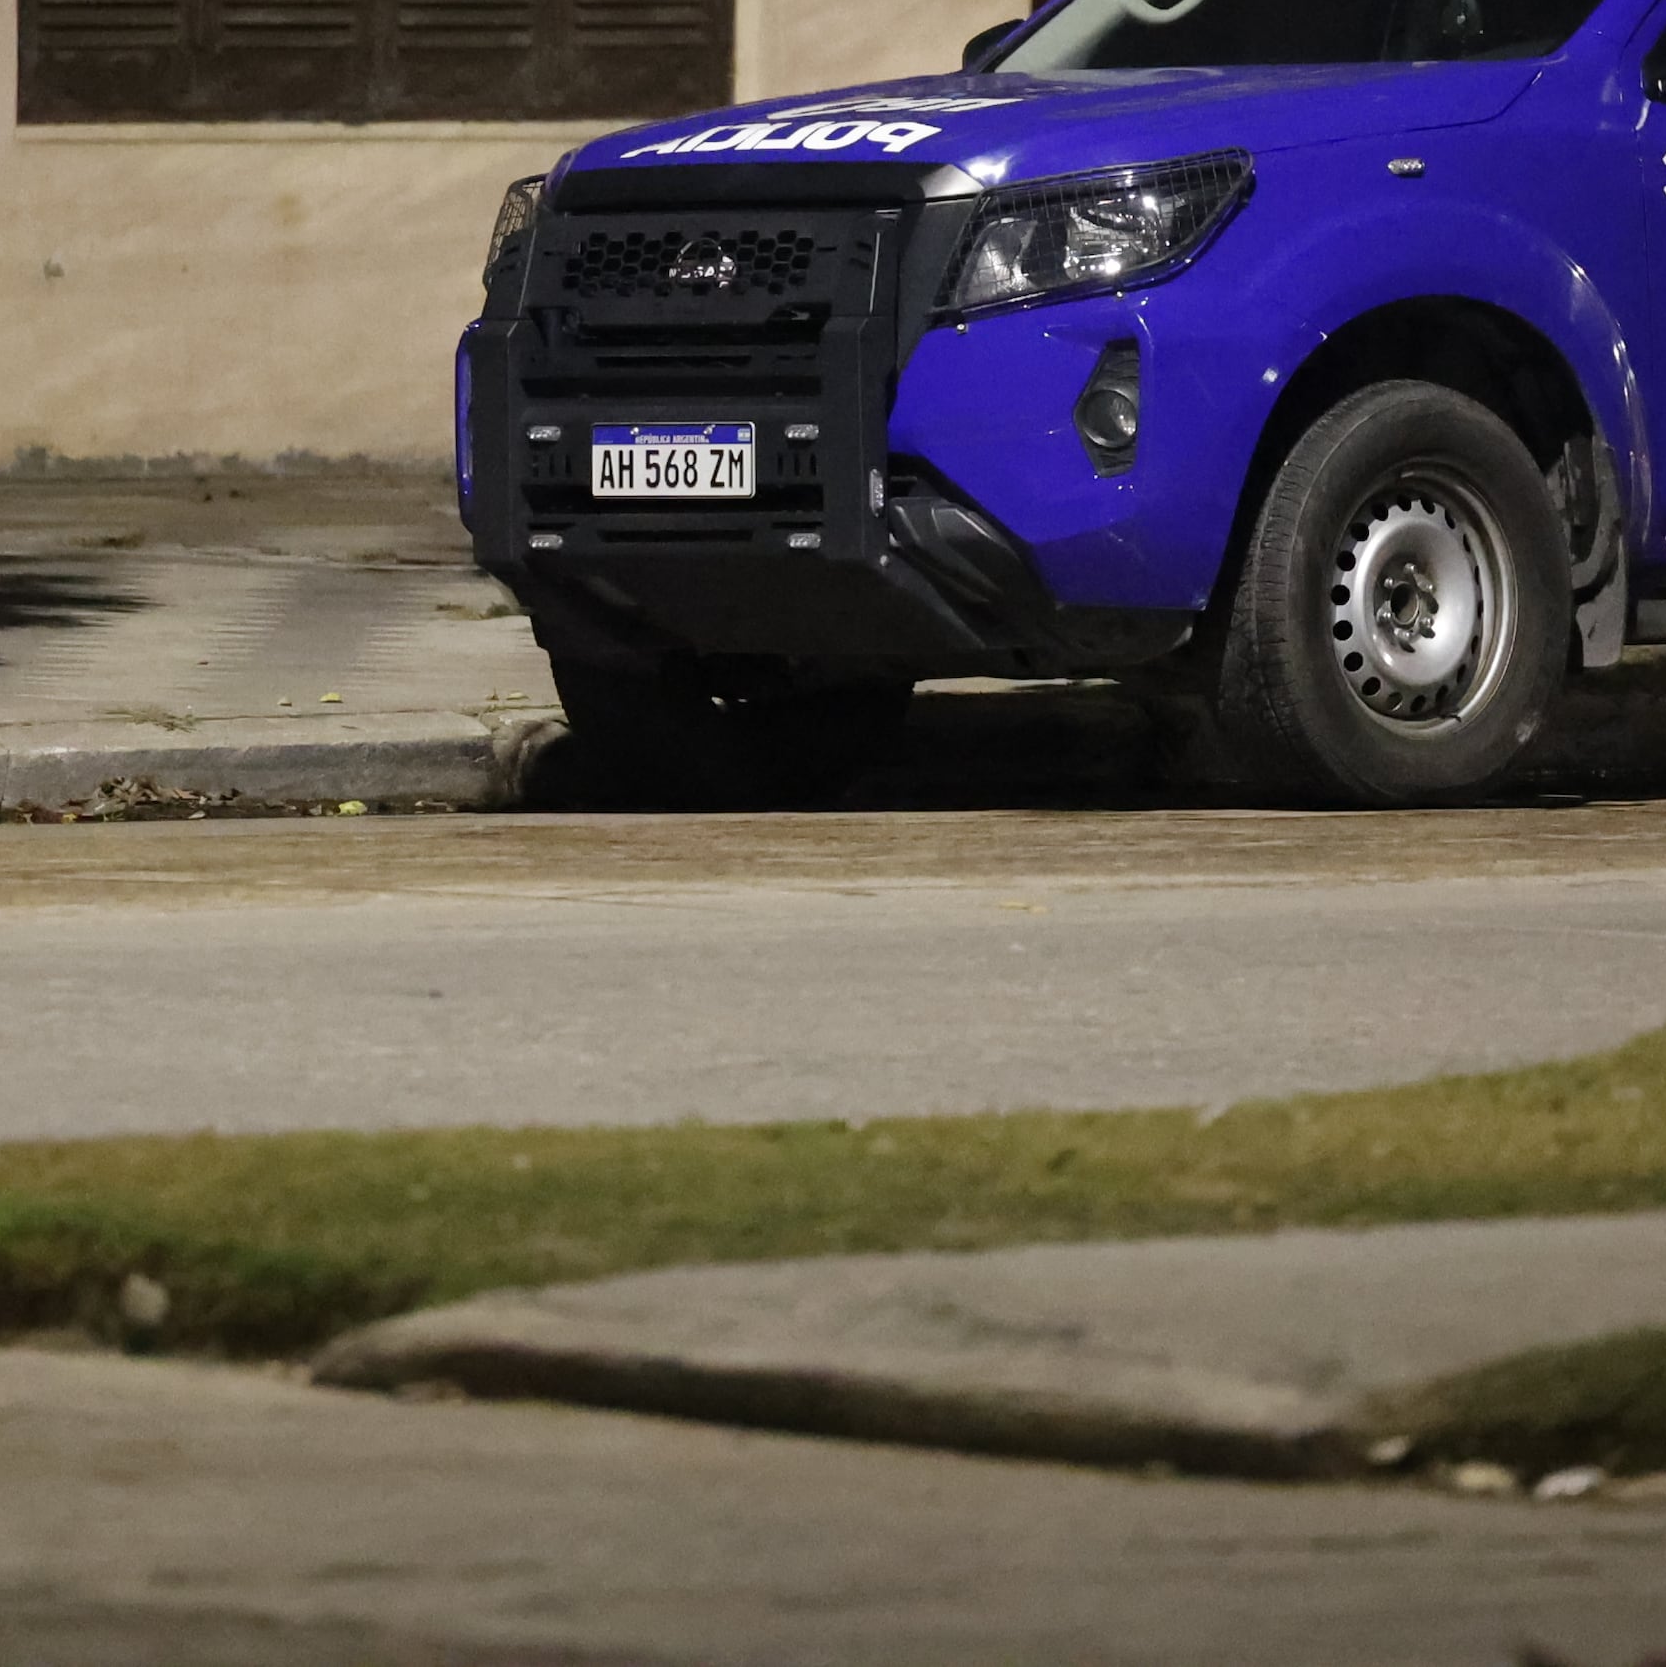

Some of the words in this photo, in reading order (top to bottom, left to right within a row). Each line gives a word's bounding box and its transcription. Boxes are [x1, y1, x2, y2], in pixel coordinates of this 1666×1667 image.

[600, 449, 634, 489] AH
[645, 449, 698, 489] 568
[709, 449, 744, 489] ZM
